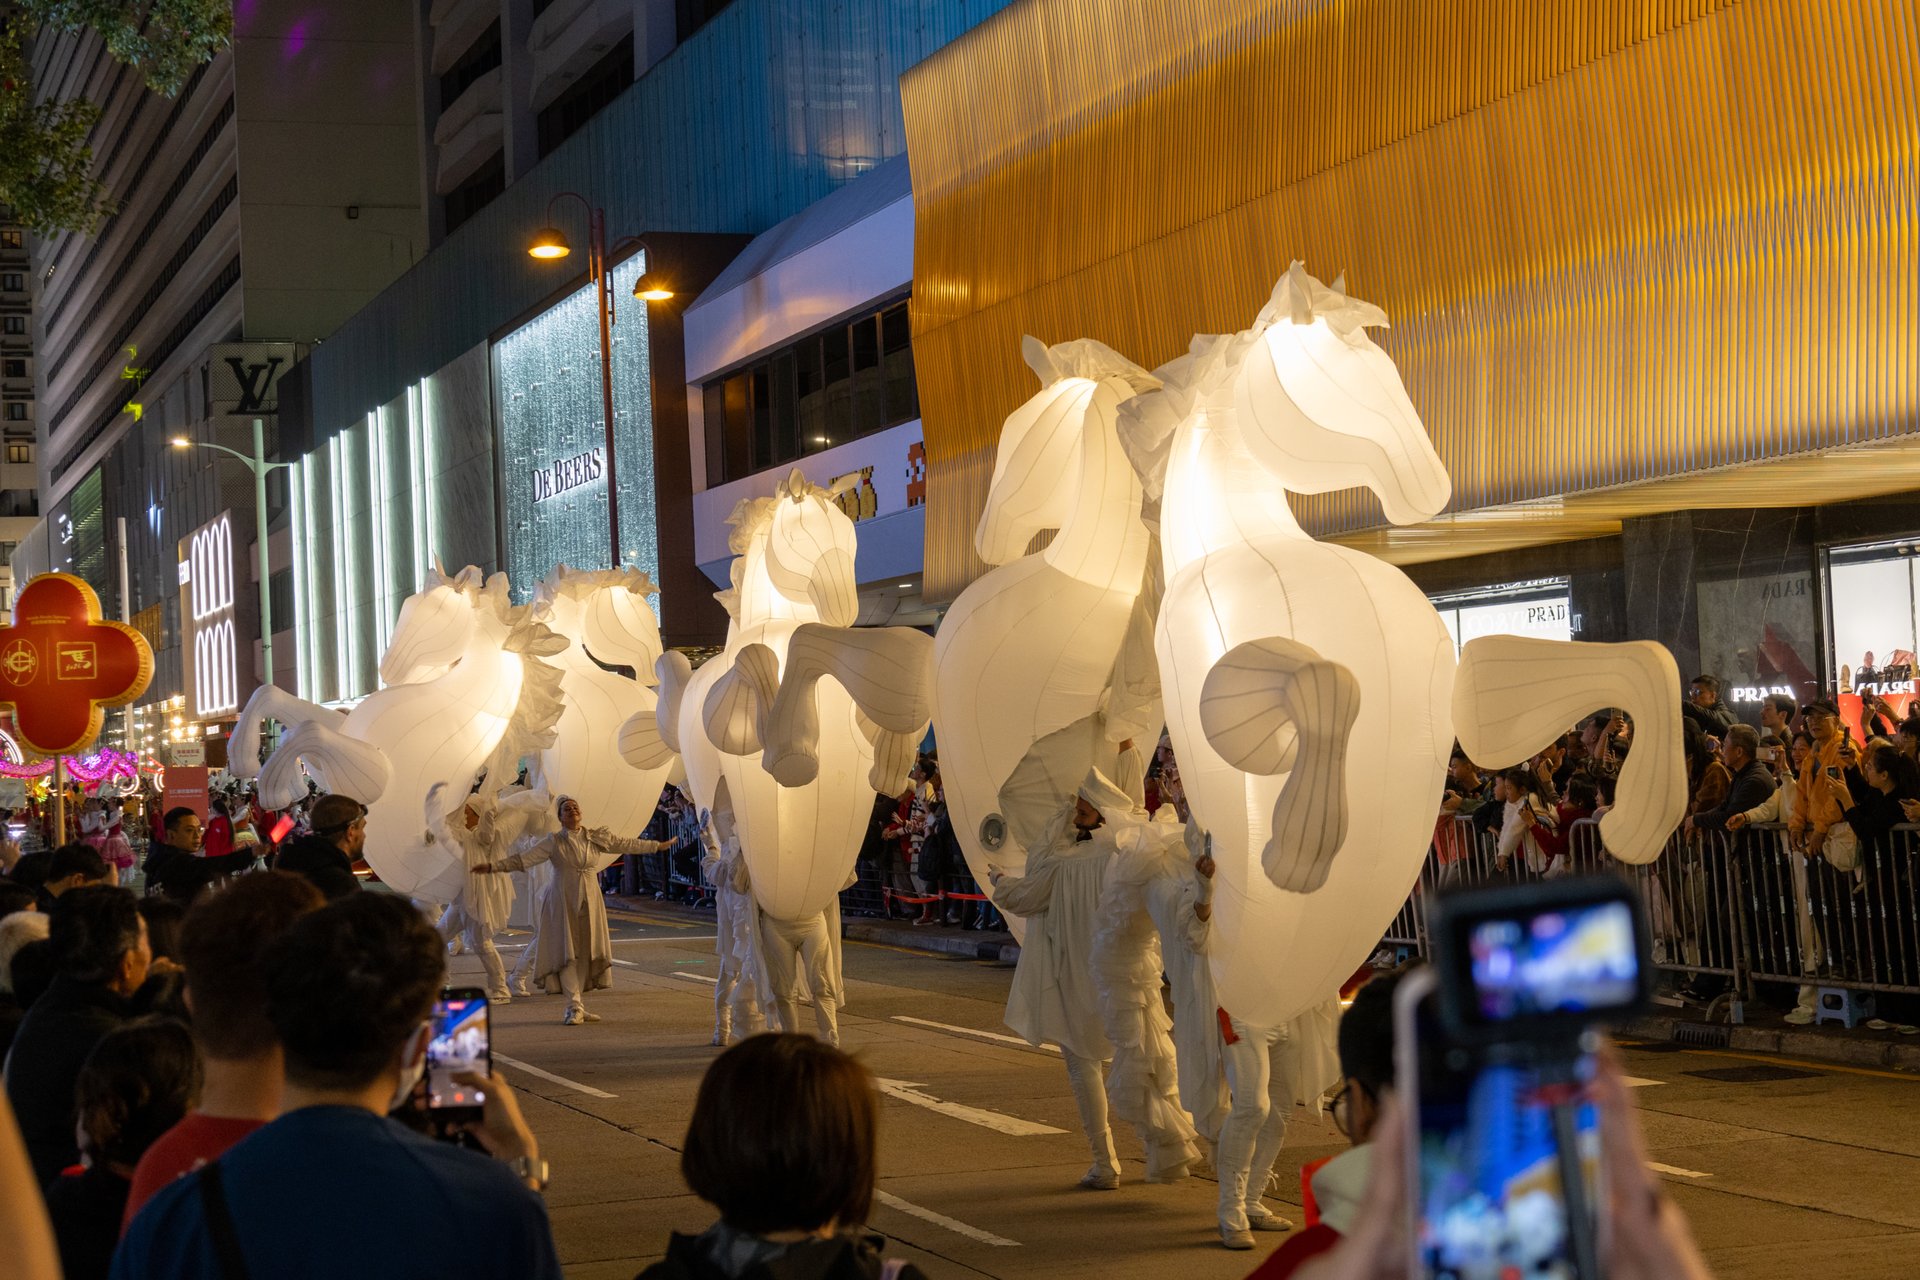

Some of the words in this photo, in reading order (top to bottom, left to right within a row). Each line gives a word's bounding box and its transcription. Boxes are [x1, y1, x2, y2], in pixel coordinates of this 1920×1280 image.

[531, 468, 552, 503] DE
[553, 447, 602, 495] BEERS
[1527, 604, 1568, 624] PRAD
